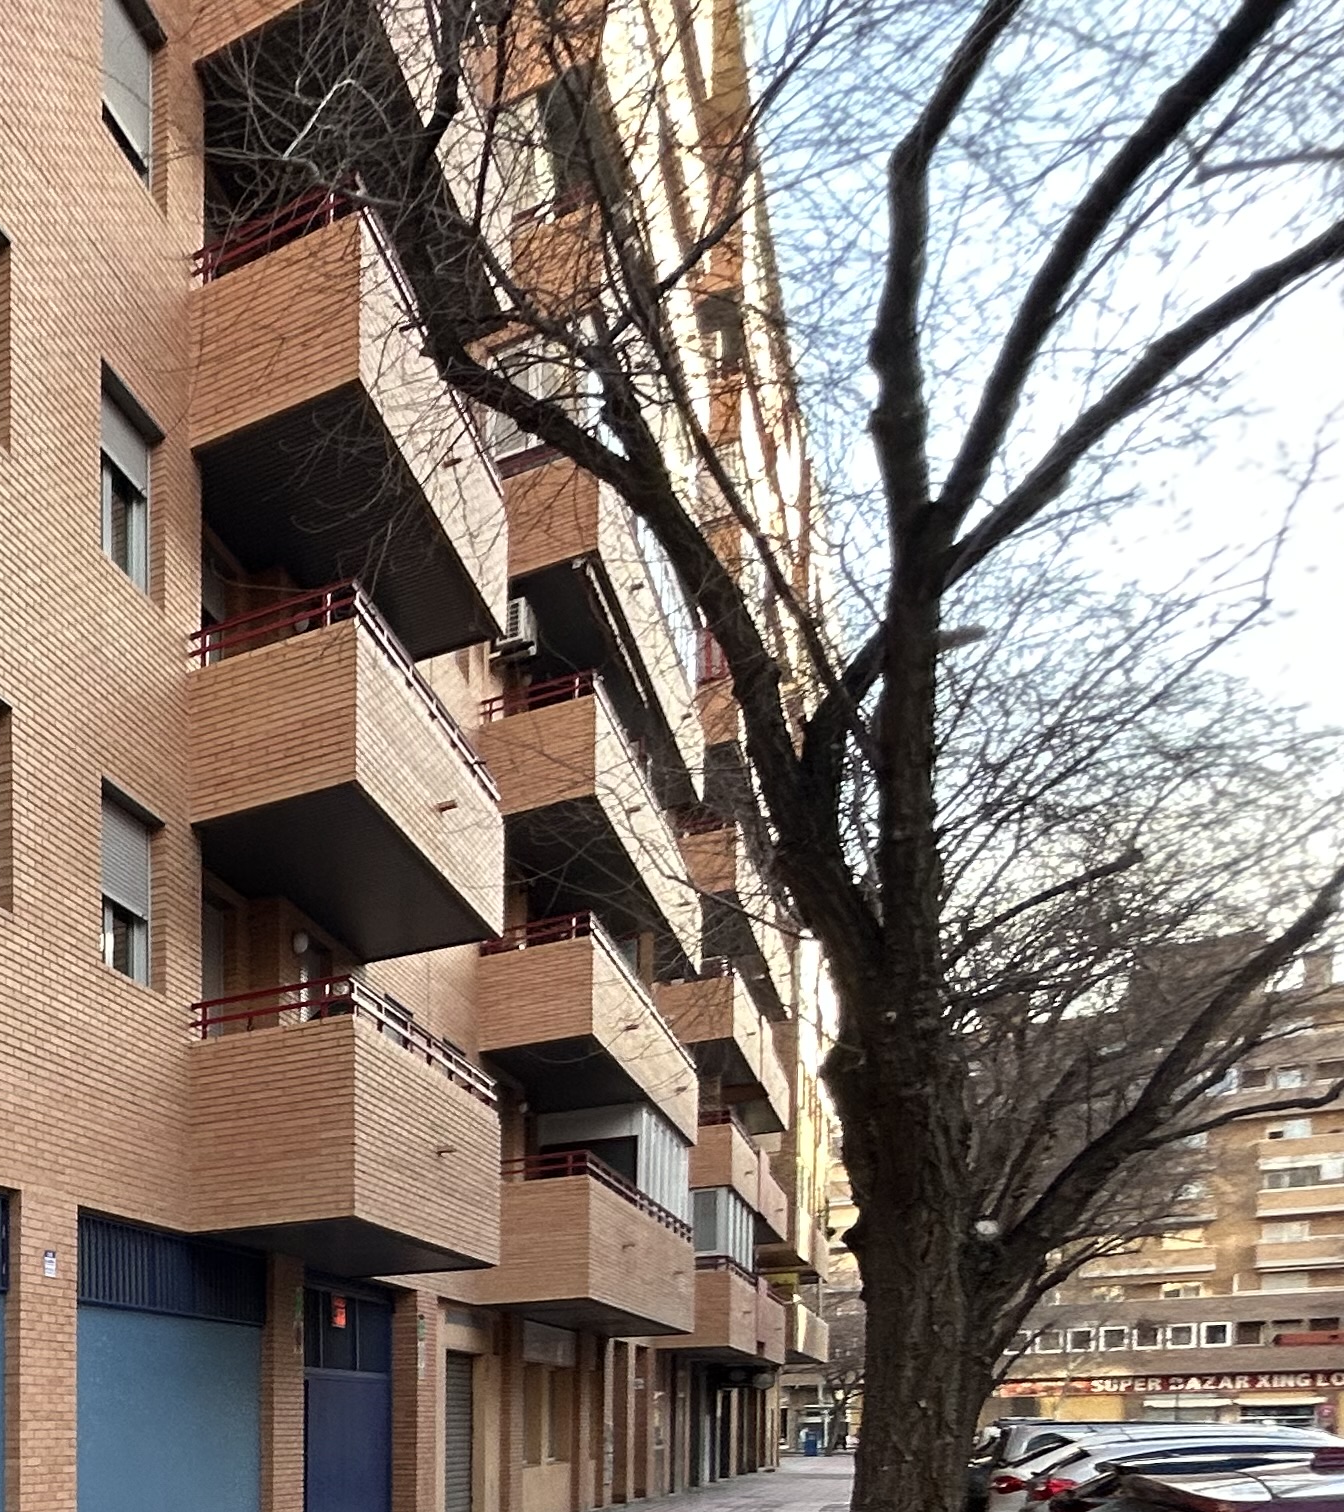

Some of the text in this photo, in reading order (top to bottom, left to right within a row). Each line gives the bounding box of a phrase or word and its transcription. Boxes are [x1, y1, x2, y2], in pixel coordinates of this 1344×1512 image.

[1090, 1377, 1162, 1393] SUPER
[1169, 1374, 1250, 1391] BAZAR
[1255, 1372, 1312, 1389] XING
